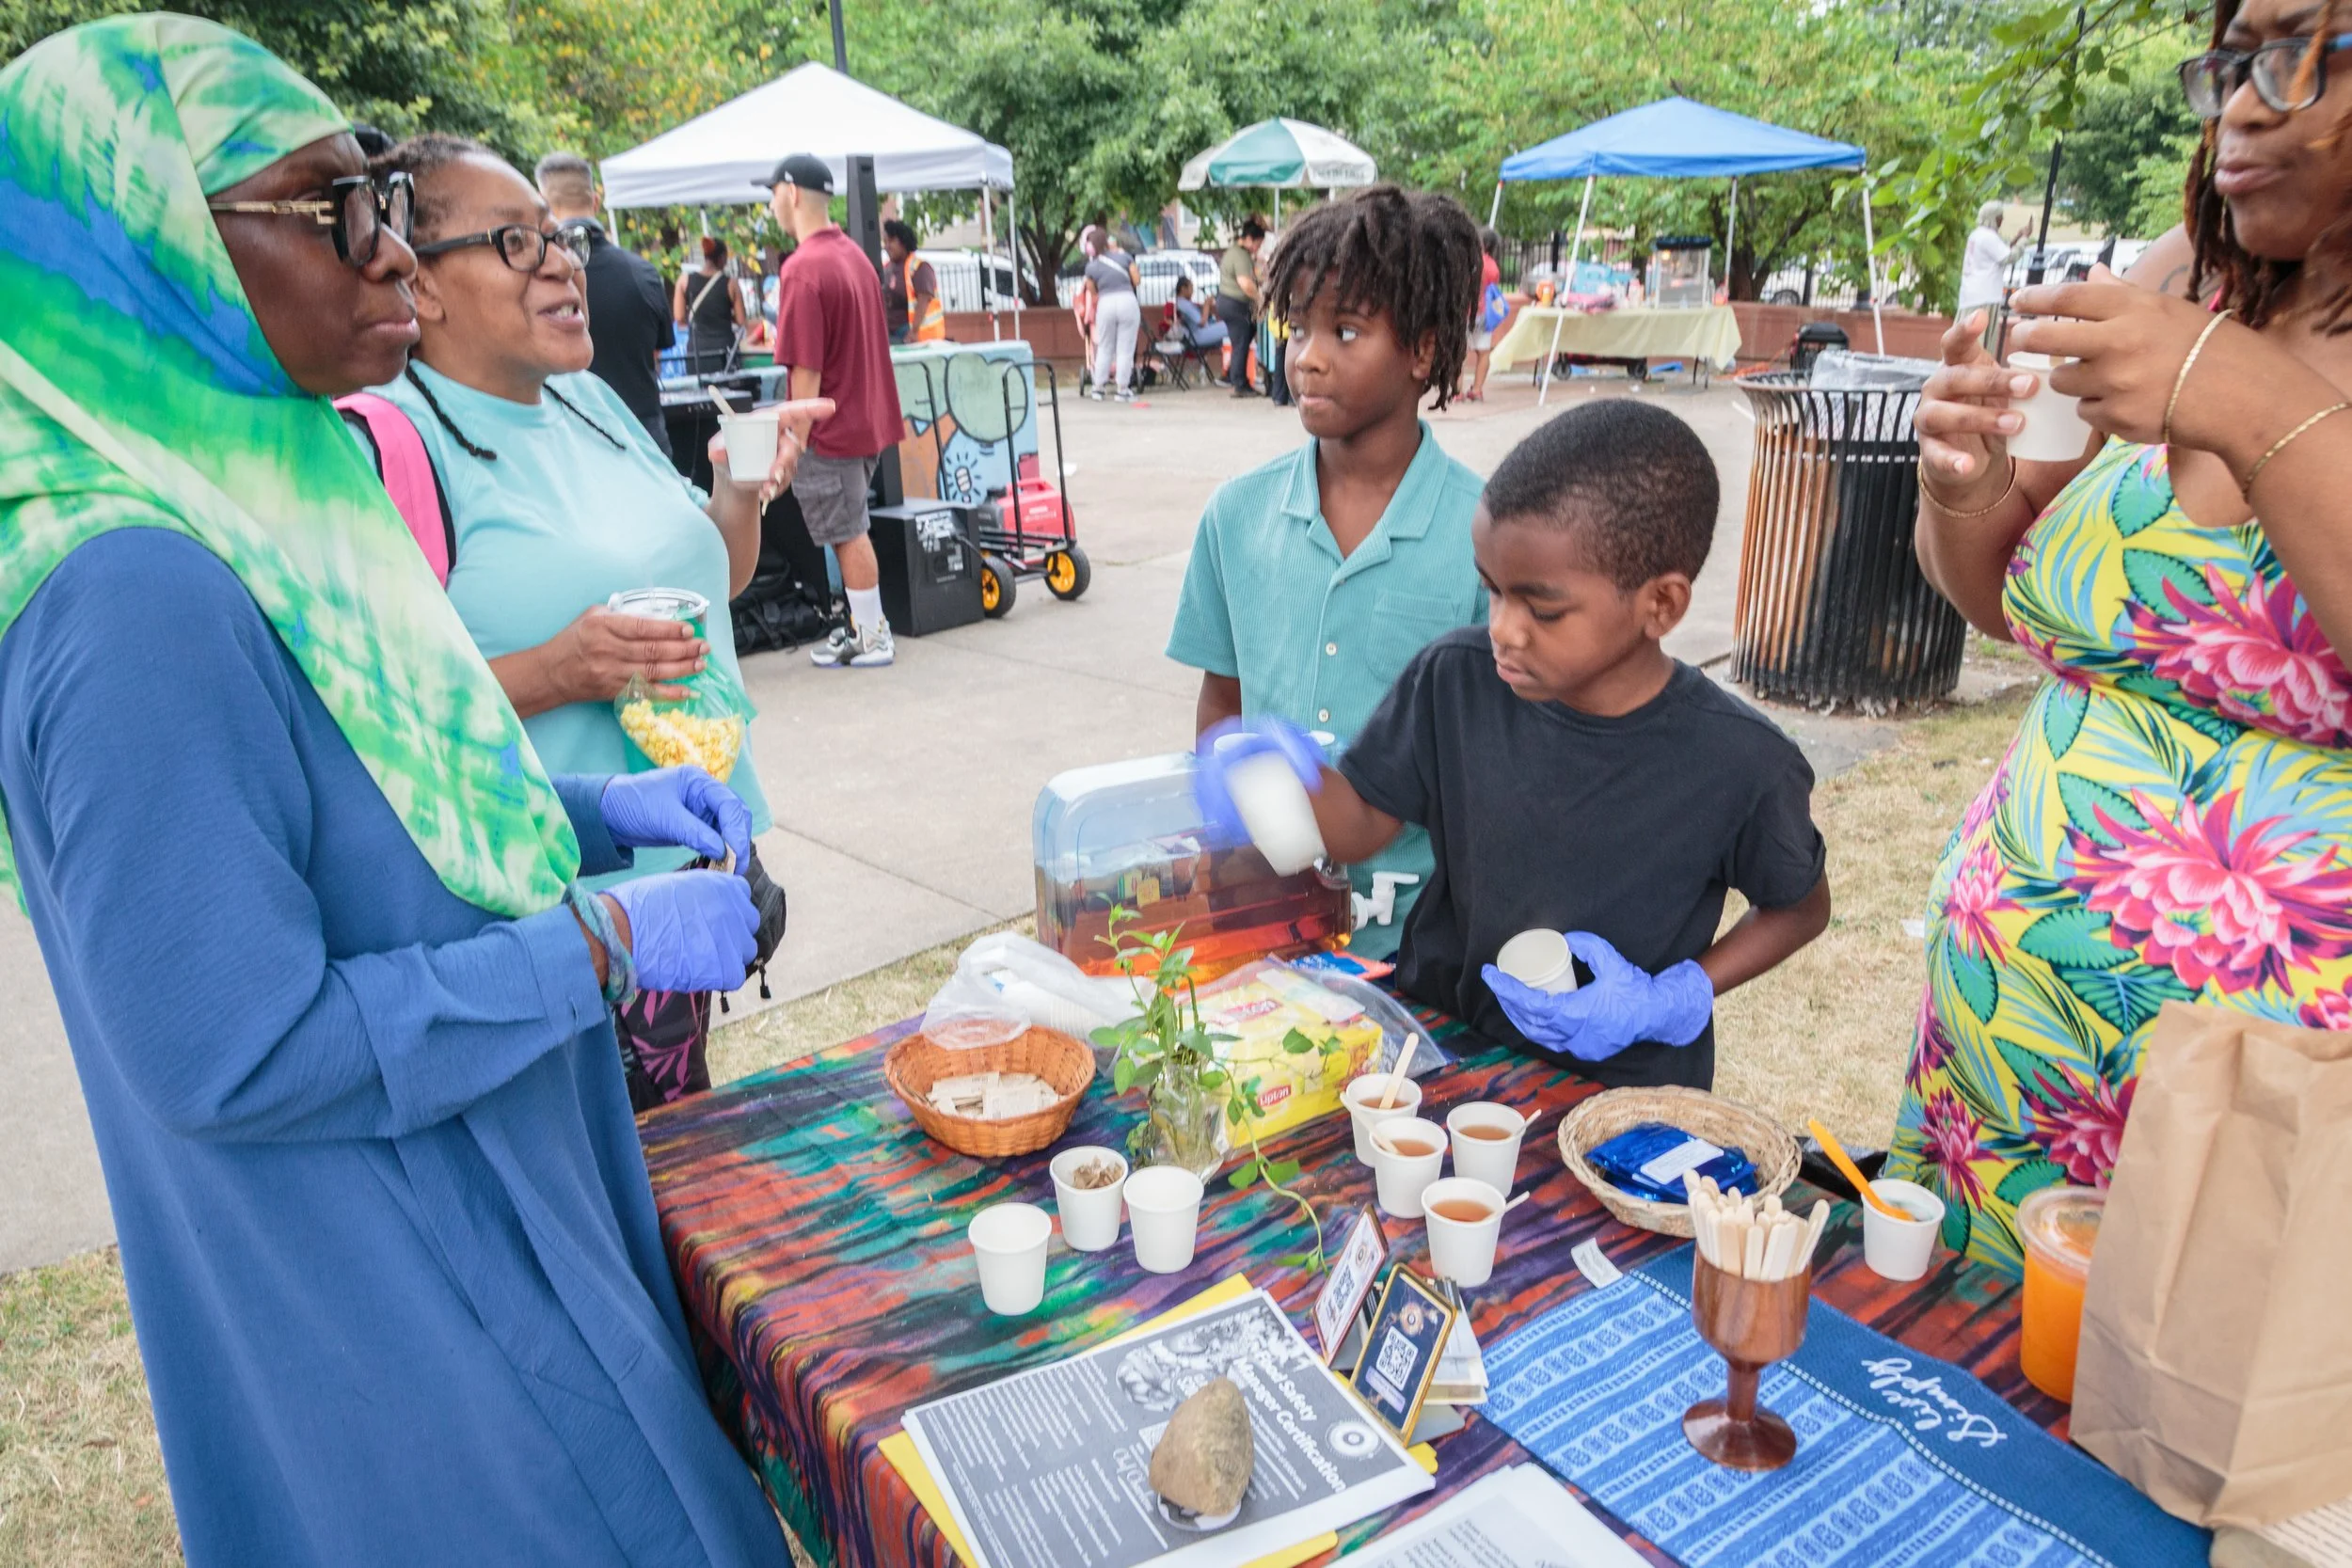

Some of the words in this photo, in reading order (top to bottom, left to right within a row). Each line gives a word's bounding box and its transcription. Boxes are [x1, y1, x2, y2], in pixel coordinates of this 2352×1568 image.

[1259, 1085, 1290, 1107] Lipton
[1279, 1380, 1317, 1421] Safety
[1235, 1362, 1281, 1412] Manager
[1277, 1410, 1346, 1493] Certification
